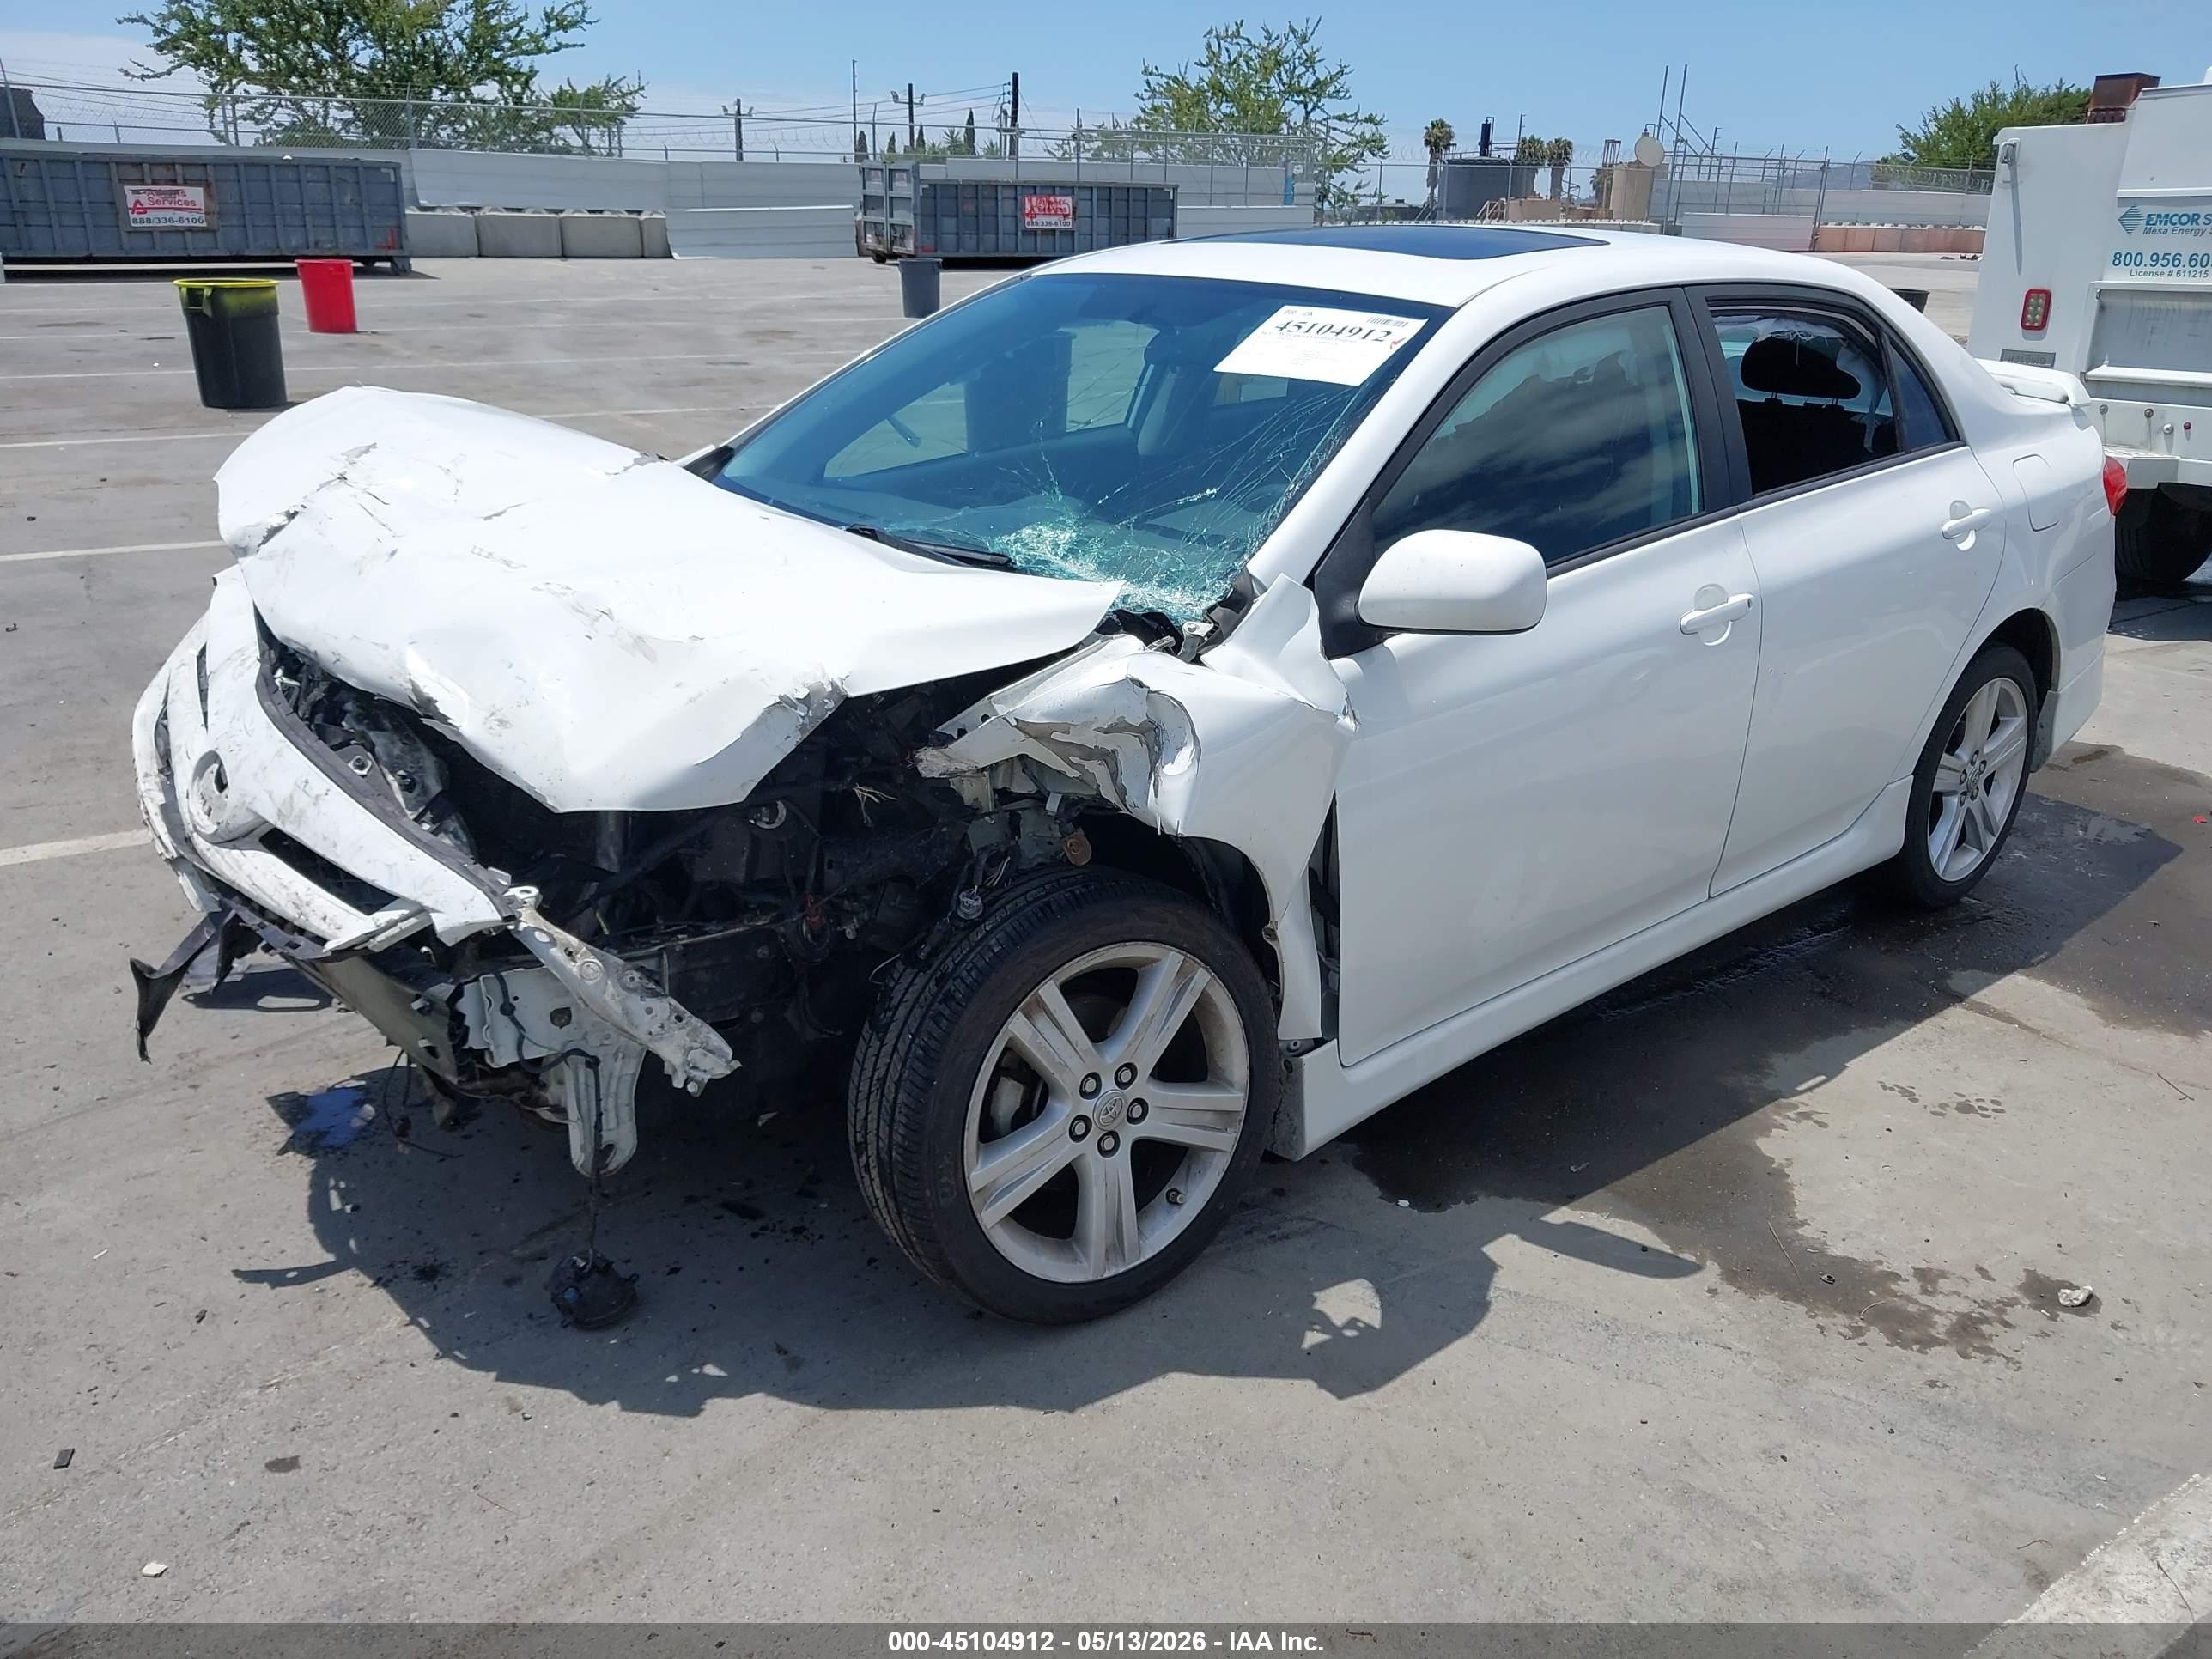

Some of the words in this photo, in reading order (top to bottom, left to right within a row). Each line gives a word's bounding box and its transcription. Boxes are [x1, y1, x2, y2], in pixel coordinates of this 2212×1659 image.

[147, 197, 198, 207] Services
[2145, 213, 2201, 227] EMCOR
[2143, 227, 2168, 235] Mesa
[2171, 227, 2208, 237] Energy
[2112, 252, 2212, 268] 800.956.60
[2130, 269, 2166, 277] License
[2176, 270, 2209, 278] 611215
[1275, 319, 1393, 343] 45104912
